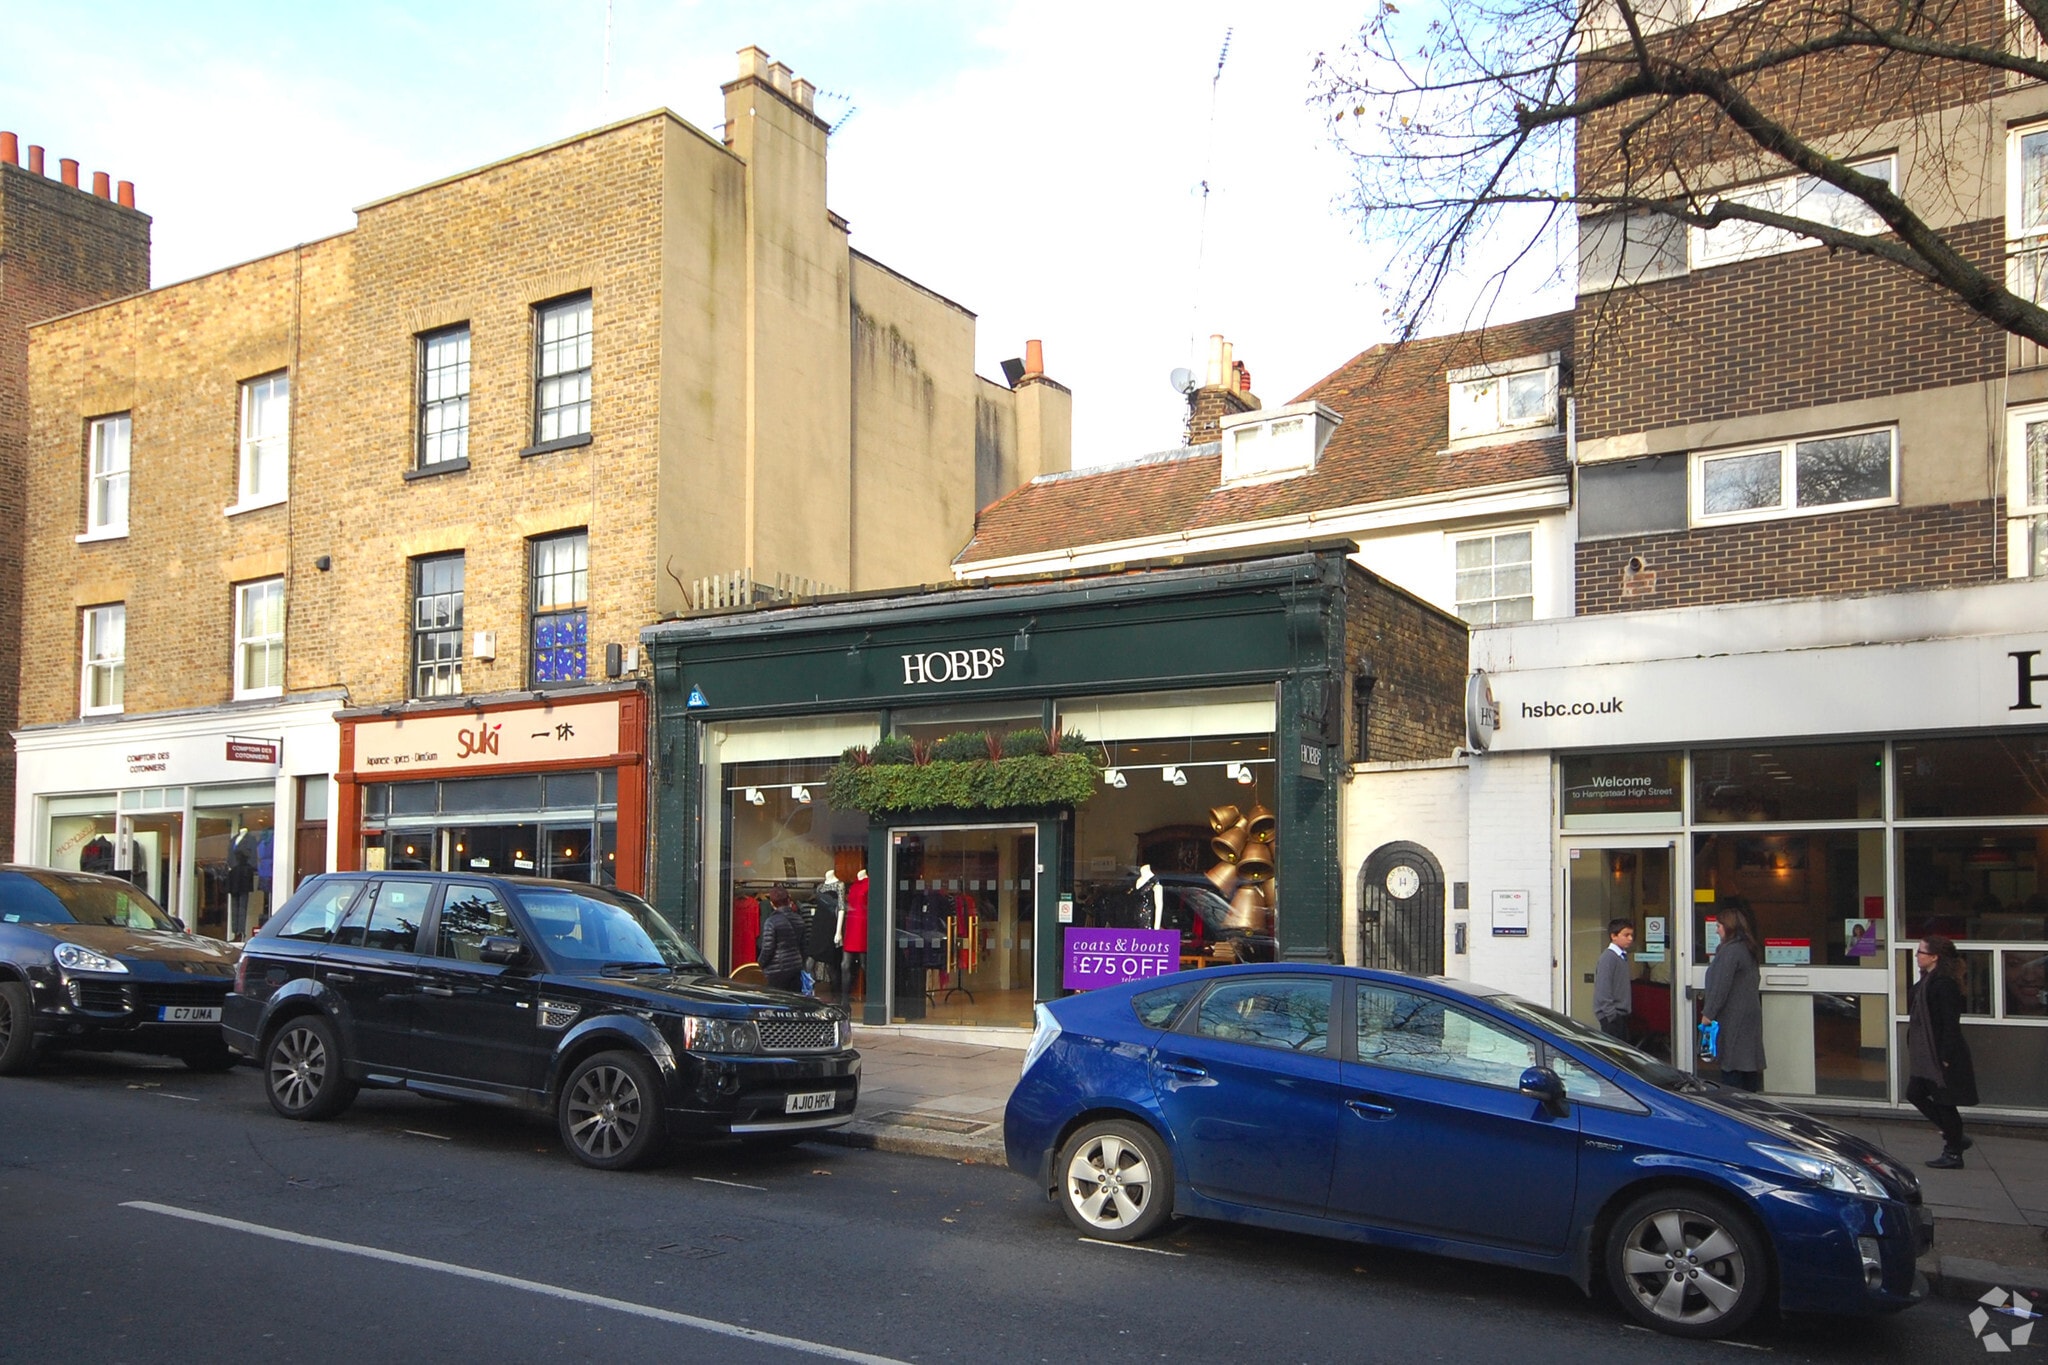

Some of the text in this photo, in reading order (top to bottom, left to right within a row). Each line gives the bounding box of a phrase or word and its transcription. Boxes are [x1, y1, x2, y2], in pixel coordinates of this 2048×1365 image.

[1521, 697, 1623, 718] hsbc.co.uk
[127, 752, 170, 763] COMPTOIR DES
[235, 752, 270, 760] COTONNIERS
[130, 763, 166, 773] COTONNIERS
[1592, 776, 1652, 787] Welcome
[1582, 789, 1626, 799] Hampstead
[1628, 788, 1646, 798] High
[1649, 787, 1672, 795] Street
[1073, 938, 1170, 953] coats & boots
[1080, 956, 1169, 976] £75 OFF
[174, 1008, 212, 1019] C7 UMA
[792, 1095, 831, 1111] AJ10 HPK
